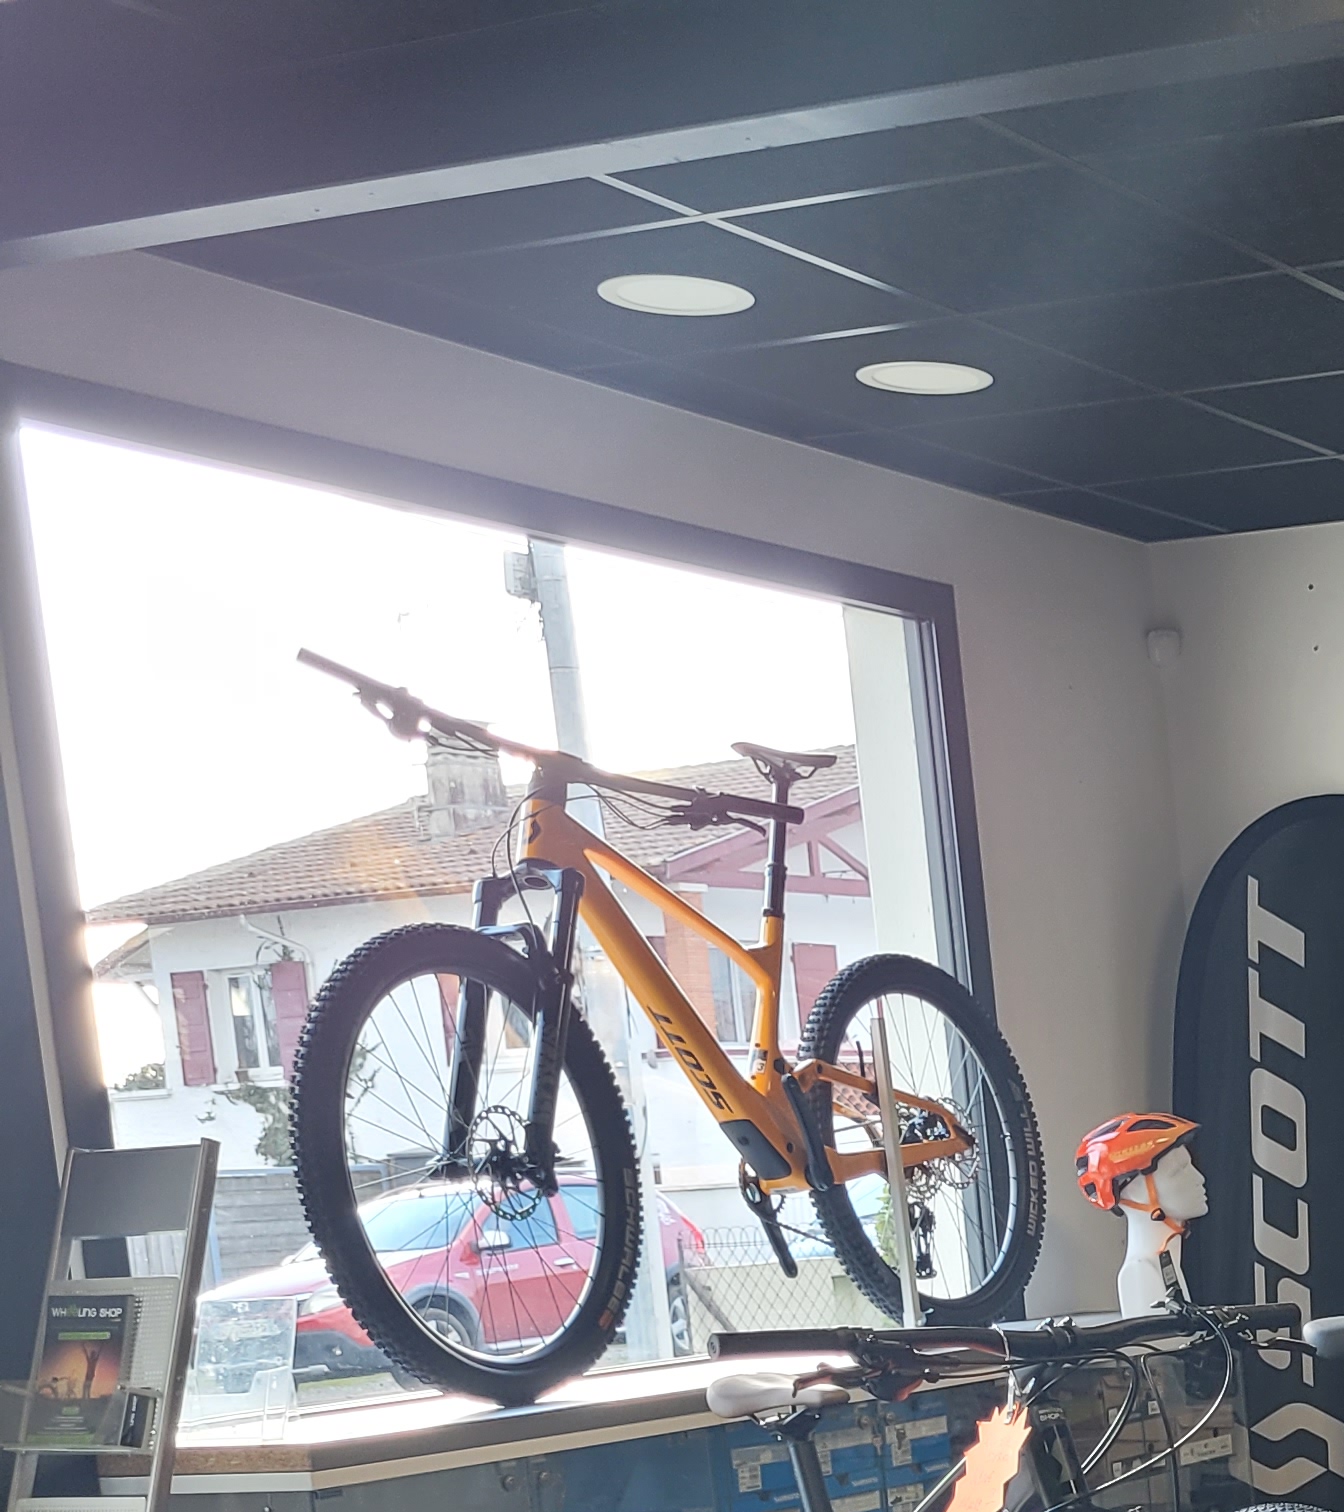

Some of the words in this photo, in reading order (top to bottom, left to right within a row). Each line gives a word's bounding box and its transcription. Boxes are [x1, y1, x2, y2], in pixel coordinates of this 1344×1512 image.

[646, 1003, 734, 1115] SCOTT
[1247, 874, 1314, 1387] SCOTT
[99, 1307, 123, 1318] SHOP
